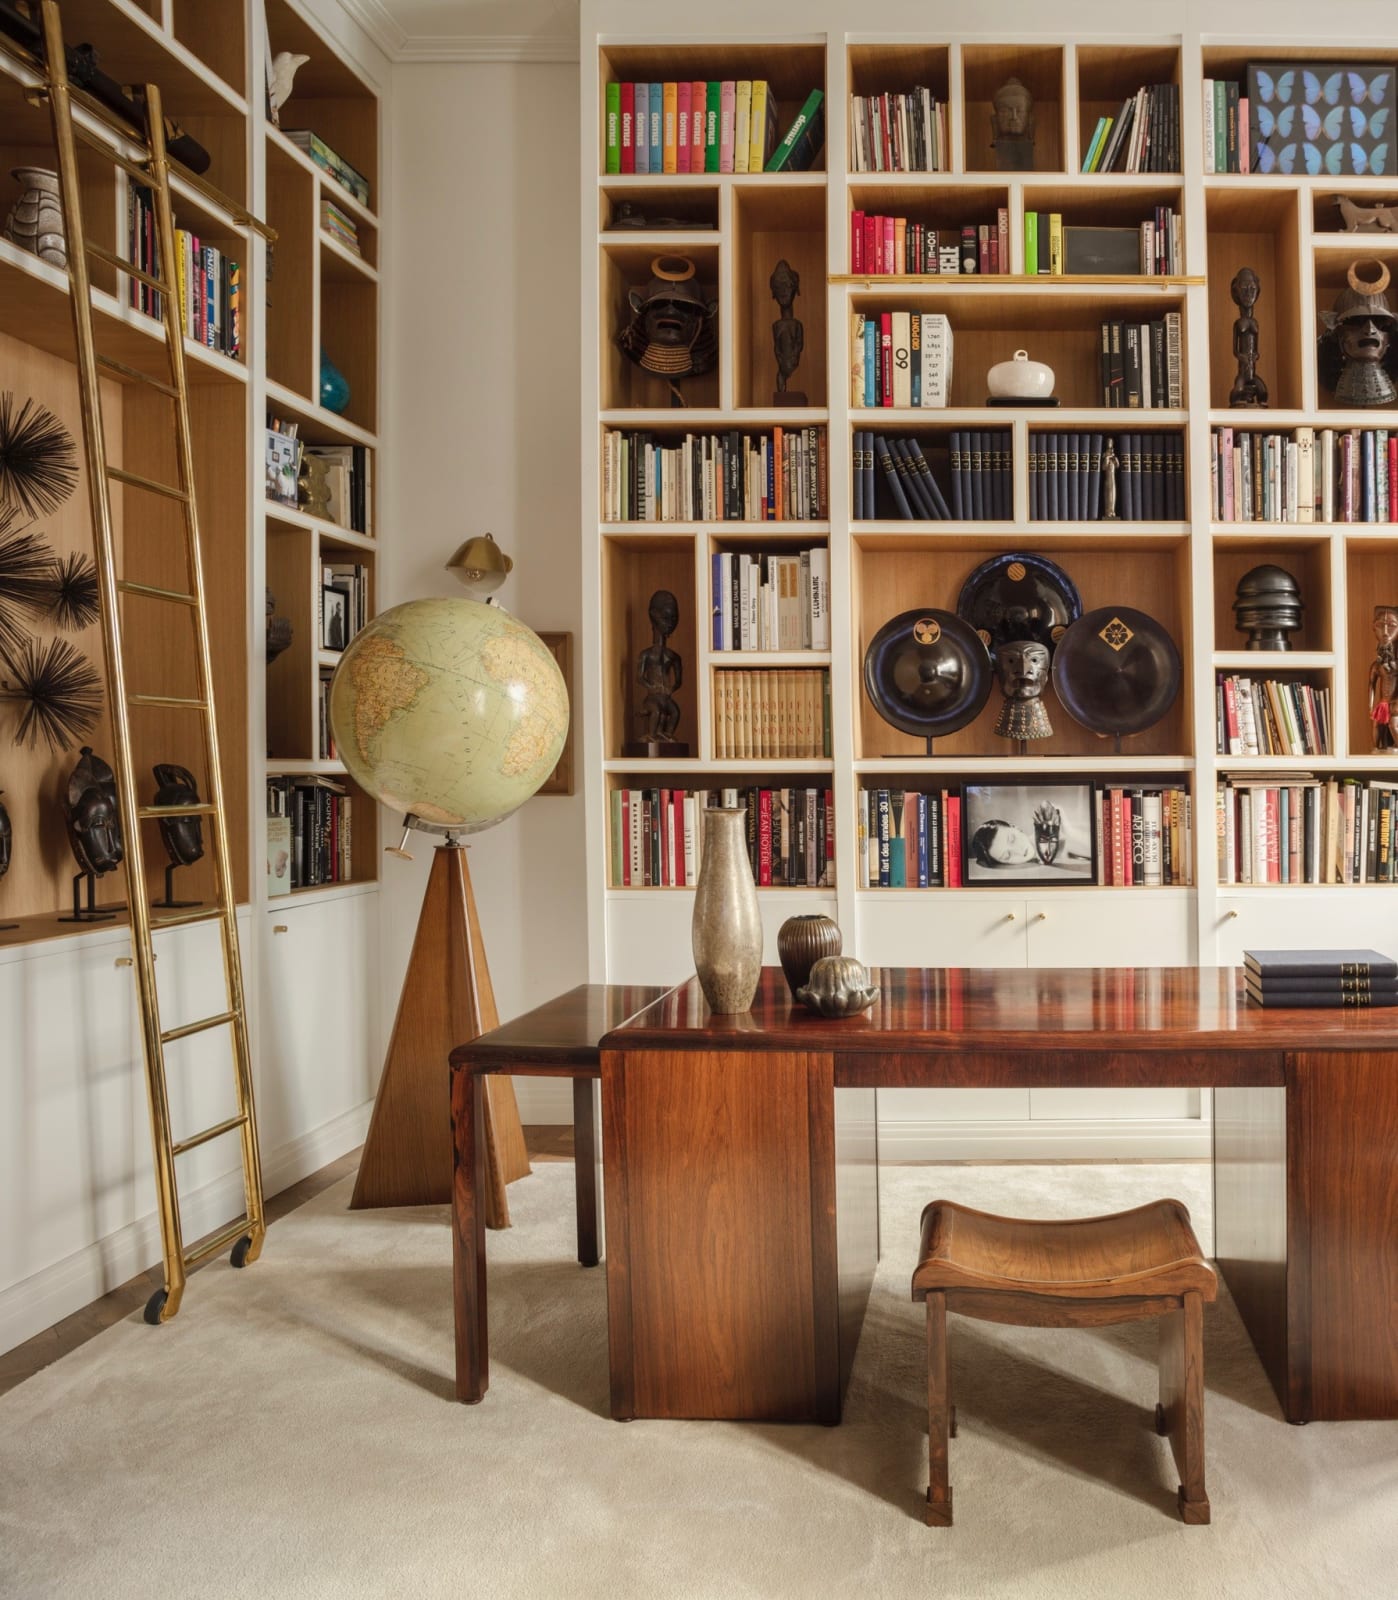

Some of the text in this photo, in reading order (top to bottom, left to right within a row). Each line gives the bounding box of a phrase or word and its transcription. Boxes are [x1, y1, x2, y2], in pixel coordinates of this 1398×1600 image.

[609, 112, 618, 147] domus
[652, 112, 660, 146] domus
[680, 112, 688, 146] domus
[694, 111, 702, 146] domus
[708, 111, 717, 146] domus
[784, 114, 806, 146] domus
[882, 334, 891, 346] 50
[912, 315, 920, 337] PONTI
[880, 802, 888, 813] 30
[1132, 814, 1144, 864] ART DECO
